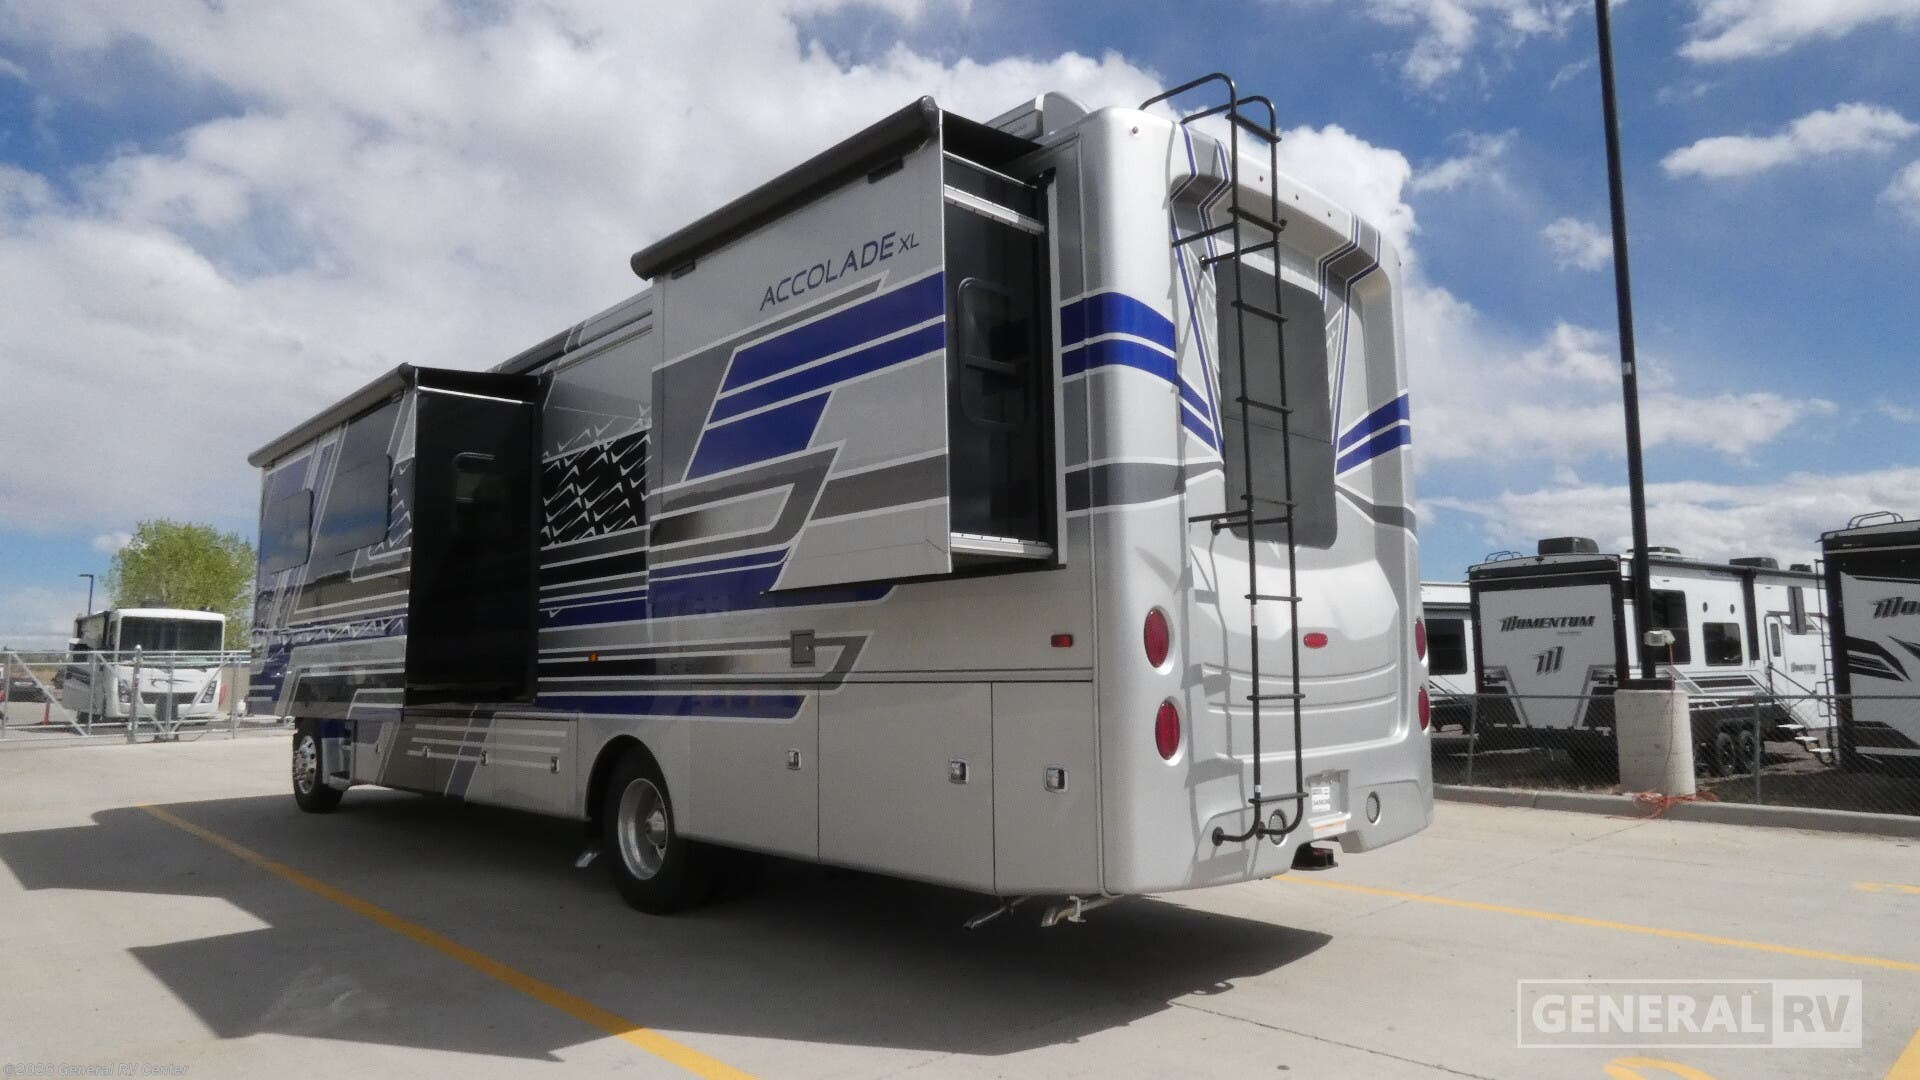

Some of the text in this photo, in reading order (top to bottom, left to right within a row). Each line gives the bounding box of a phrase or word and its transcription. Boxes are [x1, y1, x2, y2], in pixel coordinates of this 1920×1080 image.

[760, 231, 920, 311] ACCOLADE XL
[1500, 615, 1595, 632] MOMENTUM
